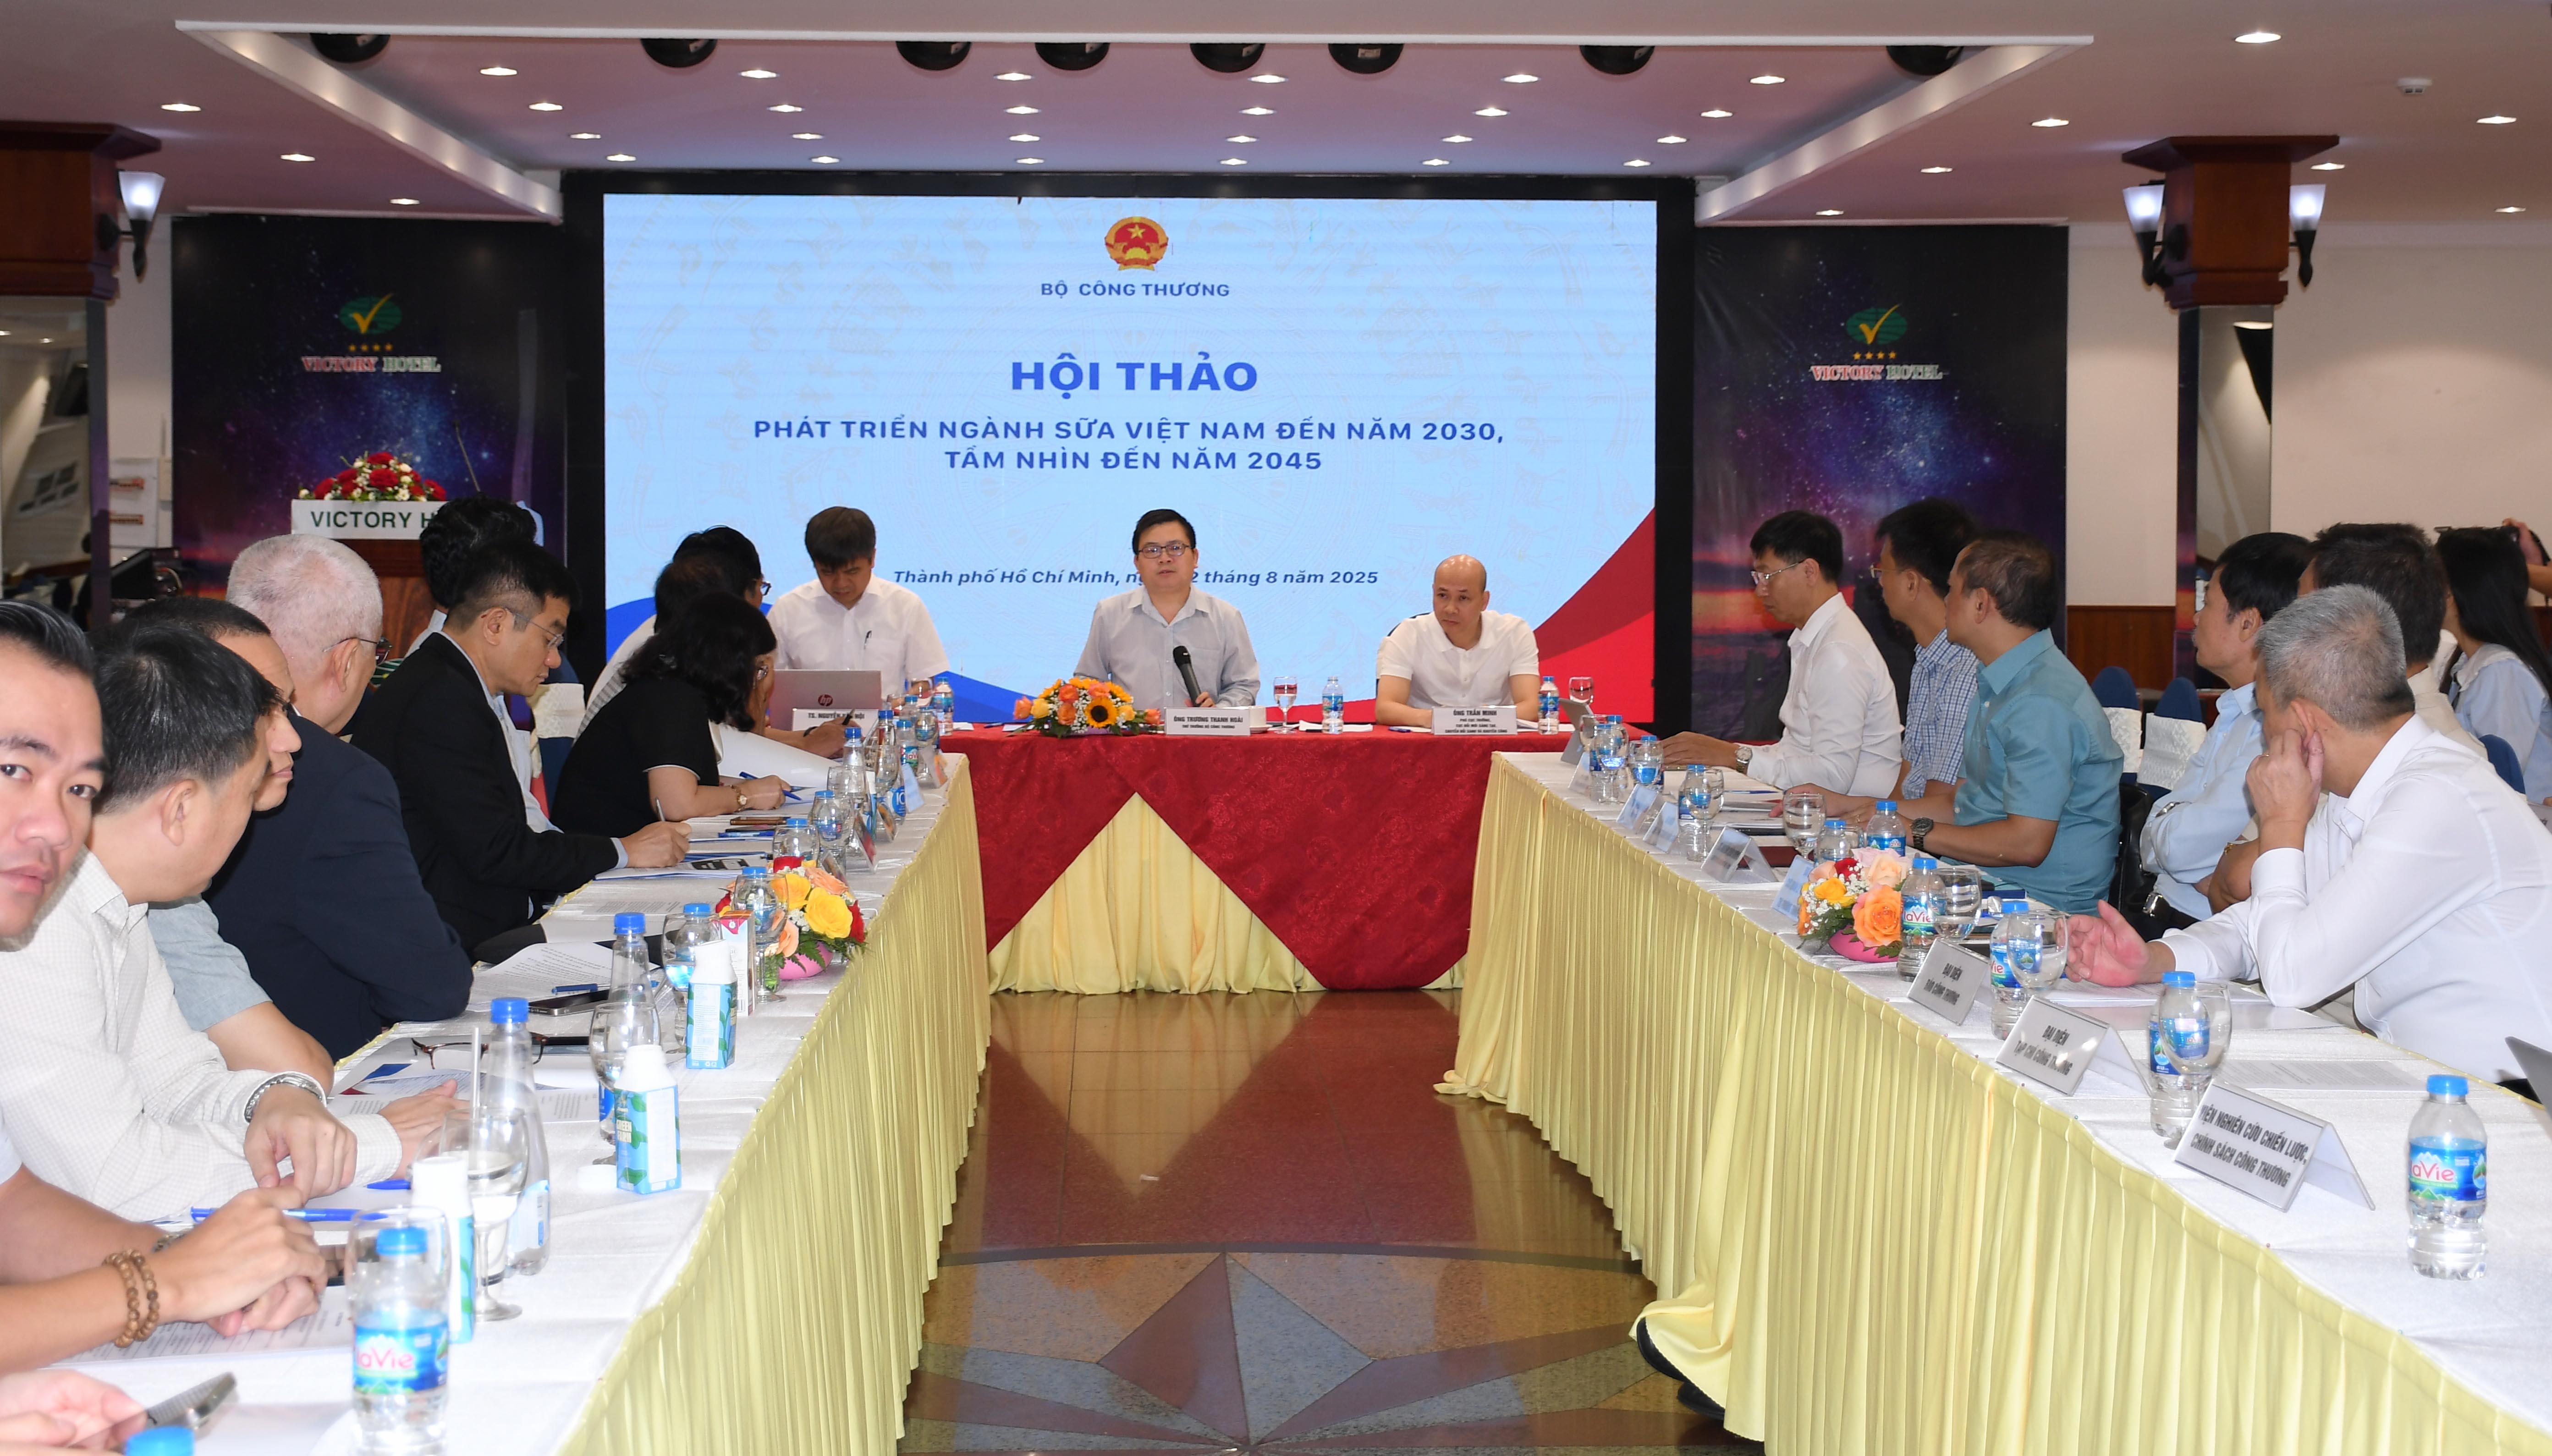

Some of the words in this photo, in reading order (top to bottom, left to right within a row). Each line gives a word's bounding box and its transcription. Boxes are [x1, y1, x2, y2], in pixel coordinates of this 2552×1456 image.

[1041, 280, 1068, 299] BỘ
[1079, 280, 1135, 296] CÔNG
[1141, 282, 1229, 297] THƯƠNG
[301, 356, 378, 373] VICTORY
[382, 356, 441, 373] HOTEL
[1810, 365, 1884, 381] VICTORY
[1886, 364, 1943, 380] HOTEL
[1012, 352, 1100, 399] HỘI
[1116, 351, 1257, 391] THẢO
[755, 416, 831, 438] PHÁT
[840, 414, 927, 438] TRIỂN
[940, 416, 1043, 439] NGÀNH
[1055, 418, 1115, 439] SỮA
[1125, 417, 1190, 444] VIỆT
[1201, 422, 1264, 439] NAM
[1276, 416, 1335, 440] ĐẾN
[1348, 418, 1411, 440] NĂM
[1423, 423, 1502, 443] 2030,
[945, 447, 1004, 468] TẦM
[1017, 446, 1089, 469] NHÌN
[1100, 448, 1160, 469] ĐẾN
[1172, 447, 1236, 469] NĂM
[1248, 452, 1321, 470] 2045
[311, 511, 412, 528] VICTORY
[894, 569, 952, 582] Thành
[957, 567, 997, 586] phố
[1000, 567, 1027, 583] Hồ
[1032, 569, 1063, 583] Chí
[1068, 570, 1119, 586] Minh,
[1204, 570, 1260, 586] tháng
[1266, 571, 1277, 583] 8
[1283, 570, 1324, 583] năm
[1330, 571, 1378, 583] 2025
[820, 694, 832, 706] hp
[2214, 1115, 2246, 1135] NGHIÊN
[2243, 1122, 2263, 1143] CỨU
[2260, 1131, 2288, 1153] CHIẾN
[2190, 1133, 2216, 1154] CHÍNH
[2213, 1142, 2237, 1164] SÁCH
[2233, 1150, 2259, 1174] CÔNG
[2256, 1160, 2291, 1188] THƯƠNG
